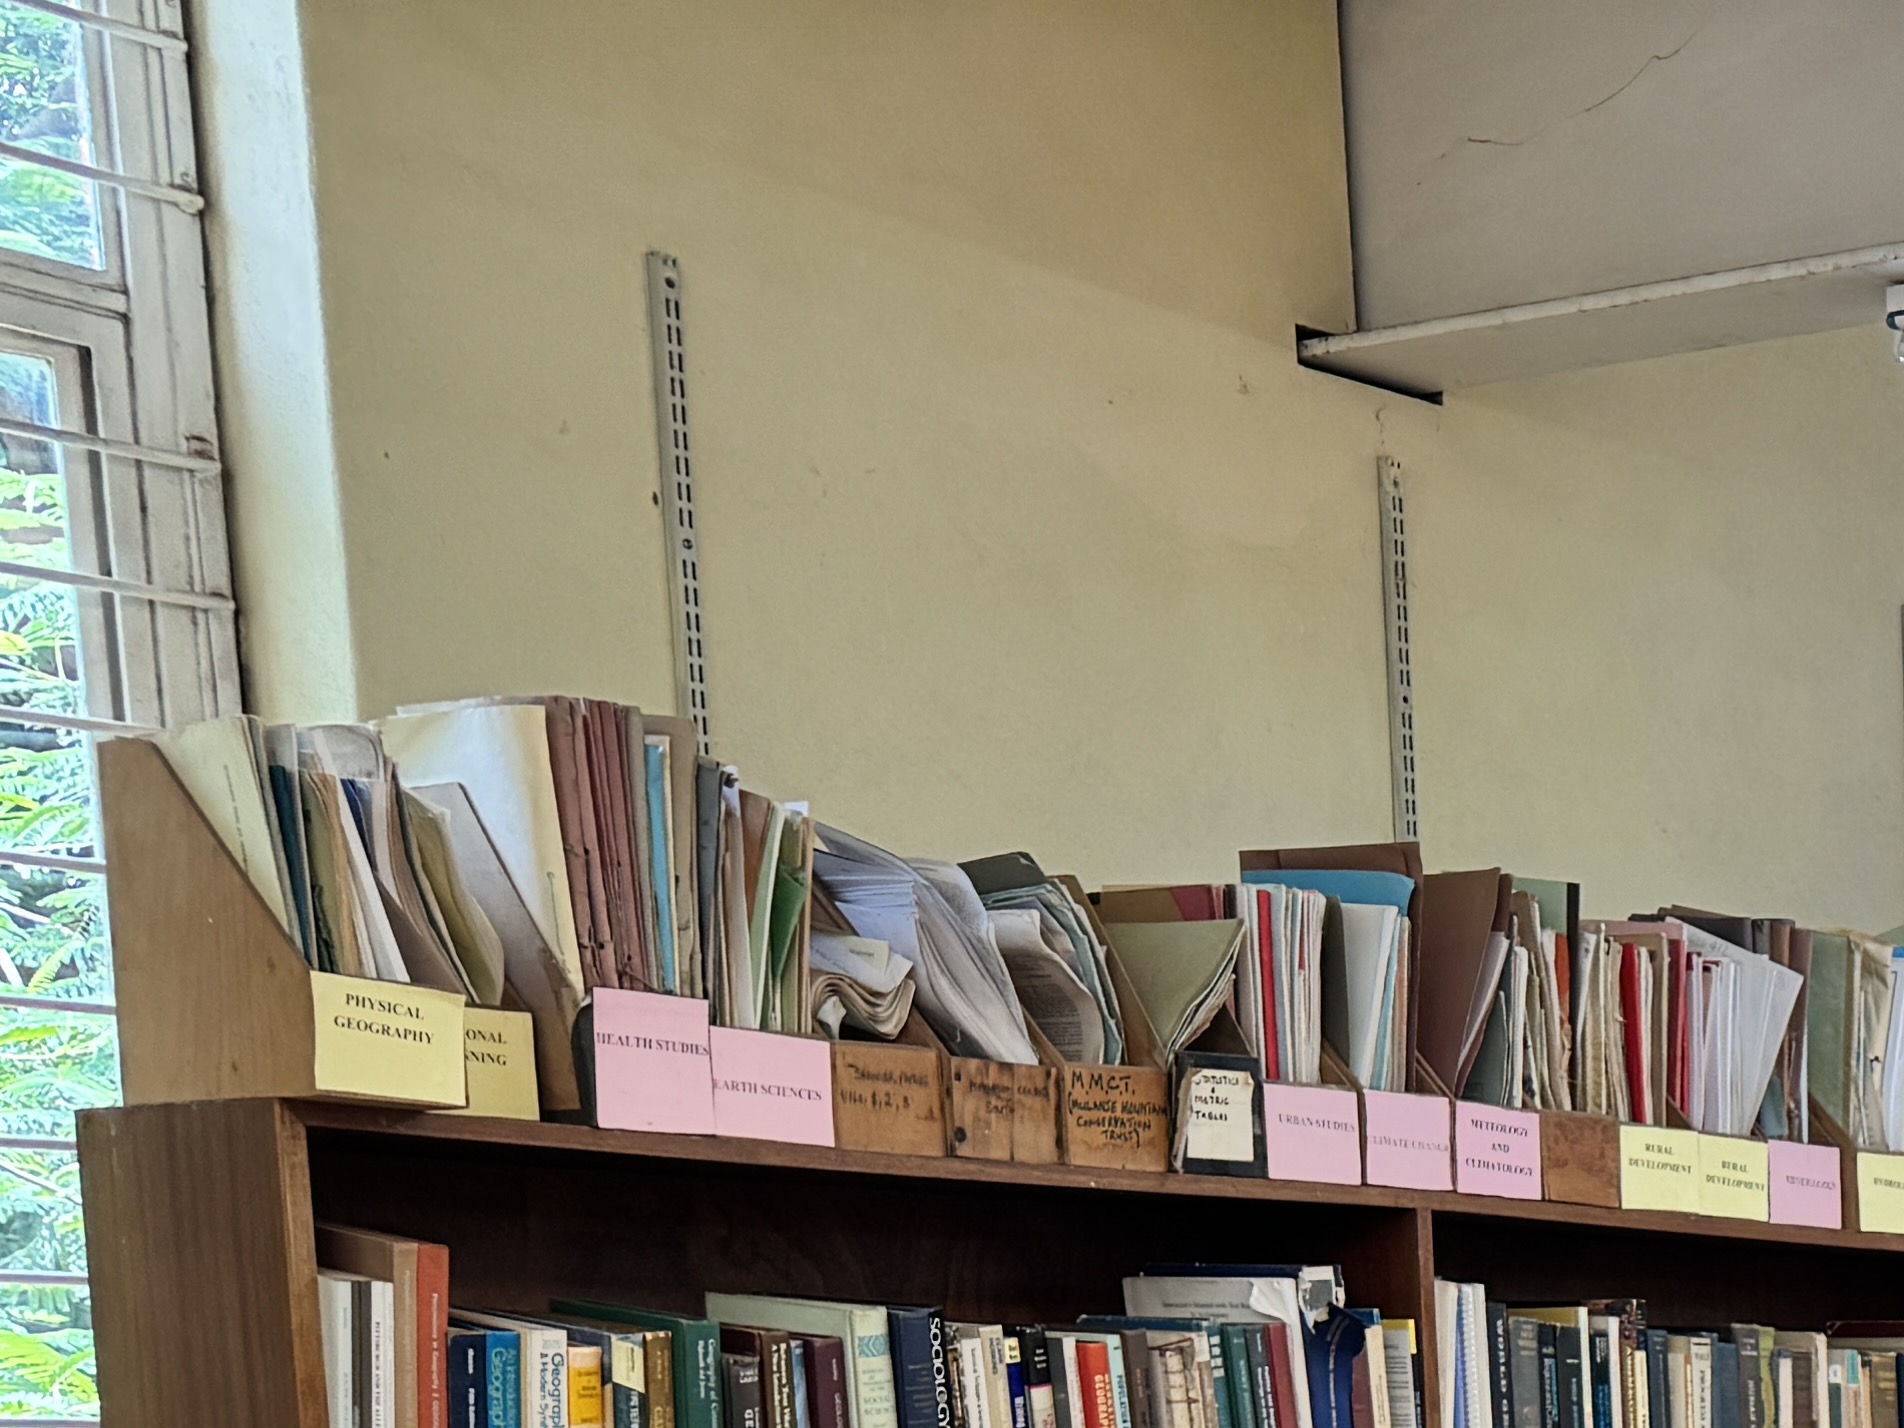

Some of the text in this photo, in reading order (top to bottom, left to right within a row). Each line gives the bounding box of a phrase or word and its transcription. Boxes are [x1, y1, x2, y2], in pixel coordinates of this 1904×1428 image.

[345, 993, 424, 1021] PHYSICAL
[334, 1015, 434, 1045] GEOGRAPHY
[466, 1028, 507, 1044] ONAL
[596, 1032, 710, 1056] HEALTH STUDIES
[465, 1051, 507, 1067] NING
[714, 1079, 822, 1101] EARTH SCIENCES
[1278, 1113, 1356, 1133] URBAN STUDIES
[1491, 1143, 1510, 1154] AND
[1628, 1157, 1692, 1174] DEVELOPMENT
[1705, 1174, 1765, 1192] DEVELOPMENT
[706, 1339, 717, 1387] Geography
[1495, 1319, 1508, 1392] WORLD
[539, 1362, 548, 1400] Modern
[507, 1366, 518, 1427] Introduction
[709, 1391, 718, 1400] of
[1014, 1396, 1027, 1428] Writing
